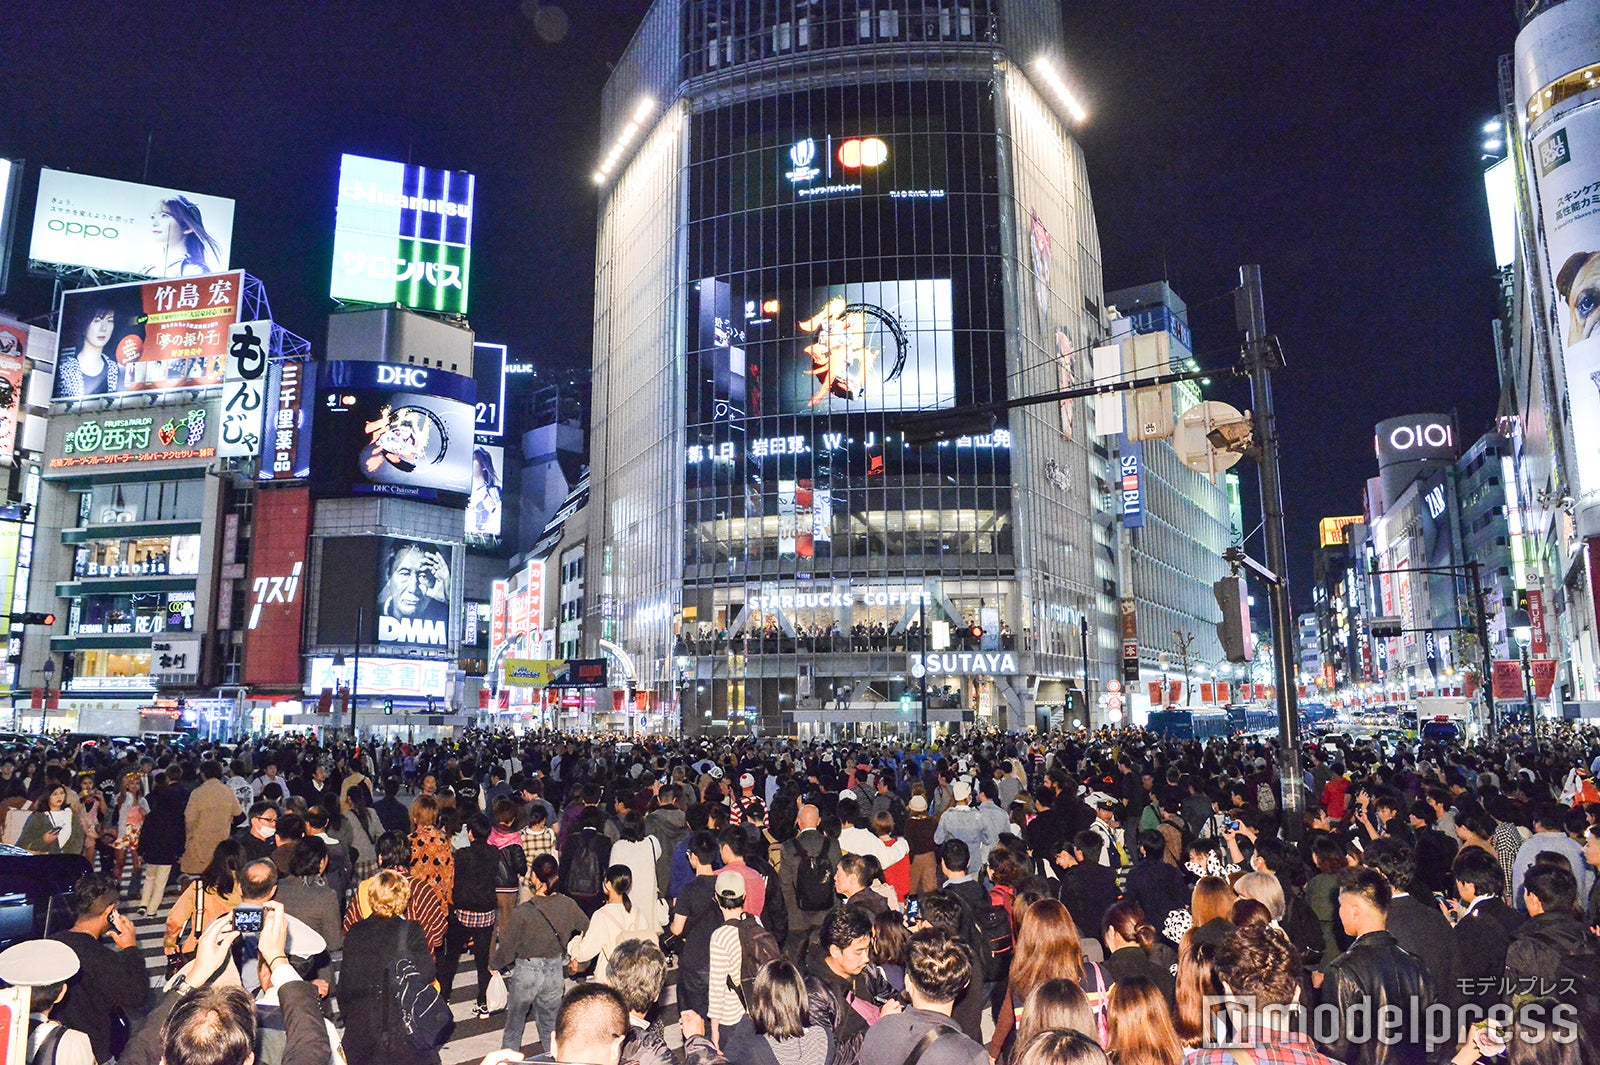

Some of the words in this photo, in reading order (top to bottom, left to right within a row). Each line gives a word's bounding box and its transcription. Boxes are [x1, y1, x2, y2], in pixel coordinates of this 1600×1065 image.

[1541, 135, 1564, 155] BULL
[1542, 147, 1565, 167] DOG
[47, 219, 119, 239] oppo
[342, 251, 463, 290] サロンパス
[377, 365, 428, 388] DHC
[222, 324, 266, 453] もんじゃ
[273, 365, 298, 472] 三千里薬品
[102, 426, 151, 450] 西村
[373, 484, 390, 492] DHC
[391, 485, 419, 495] Channel
[1121, 455, 1140, 515] SEIBU
[87, 560, 165, 578] Euphoria
[749, 592, 854, 609] STARBUCKS
[864, 591, 932, 605] COFFEE
[378, 615, 447, 646] DMM
